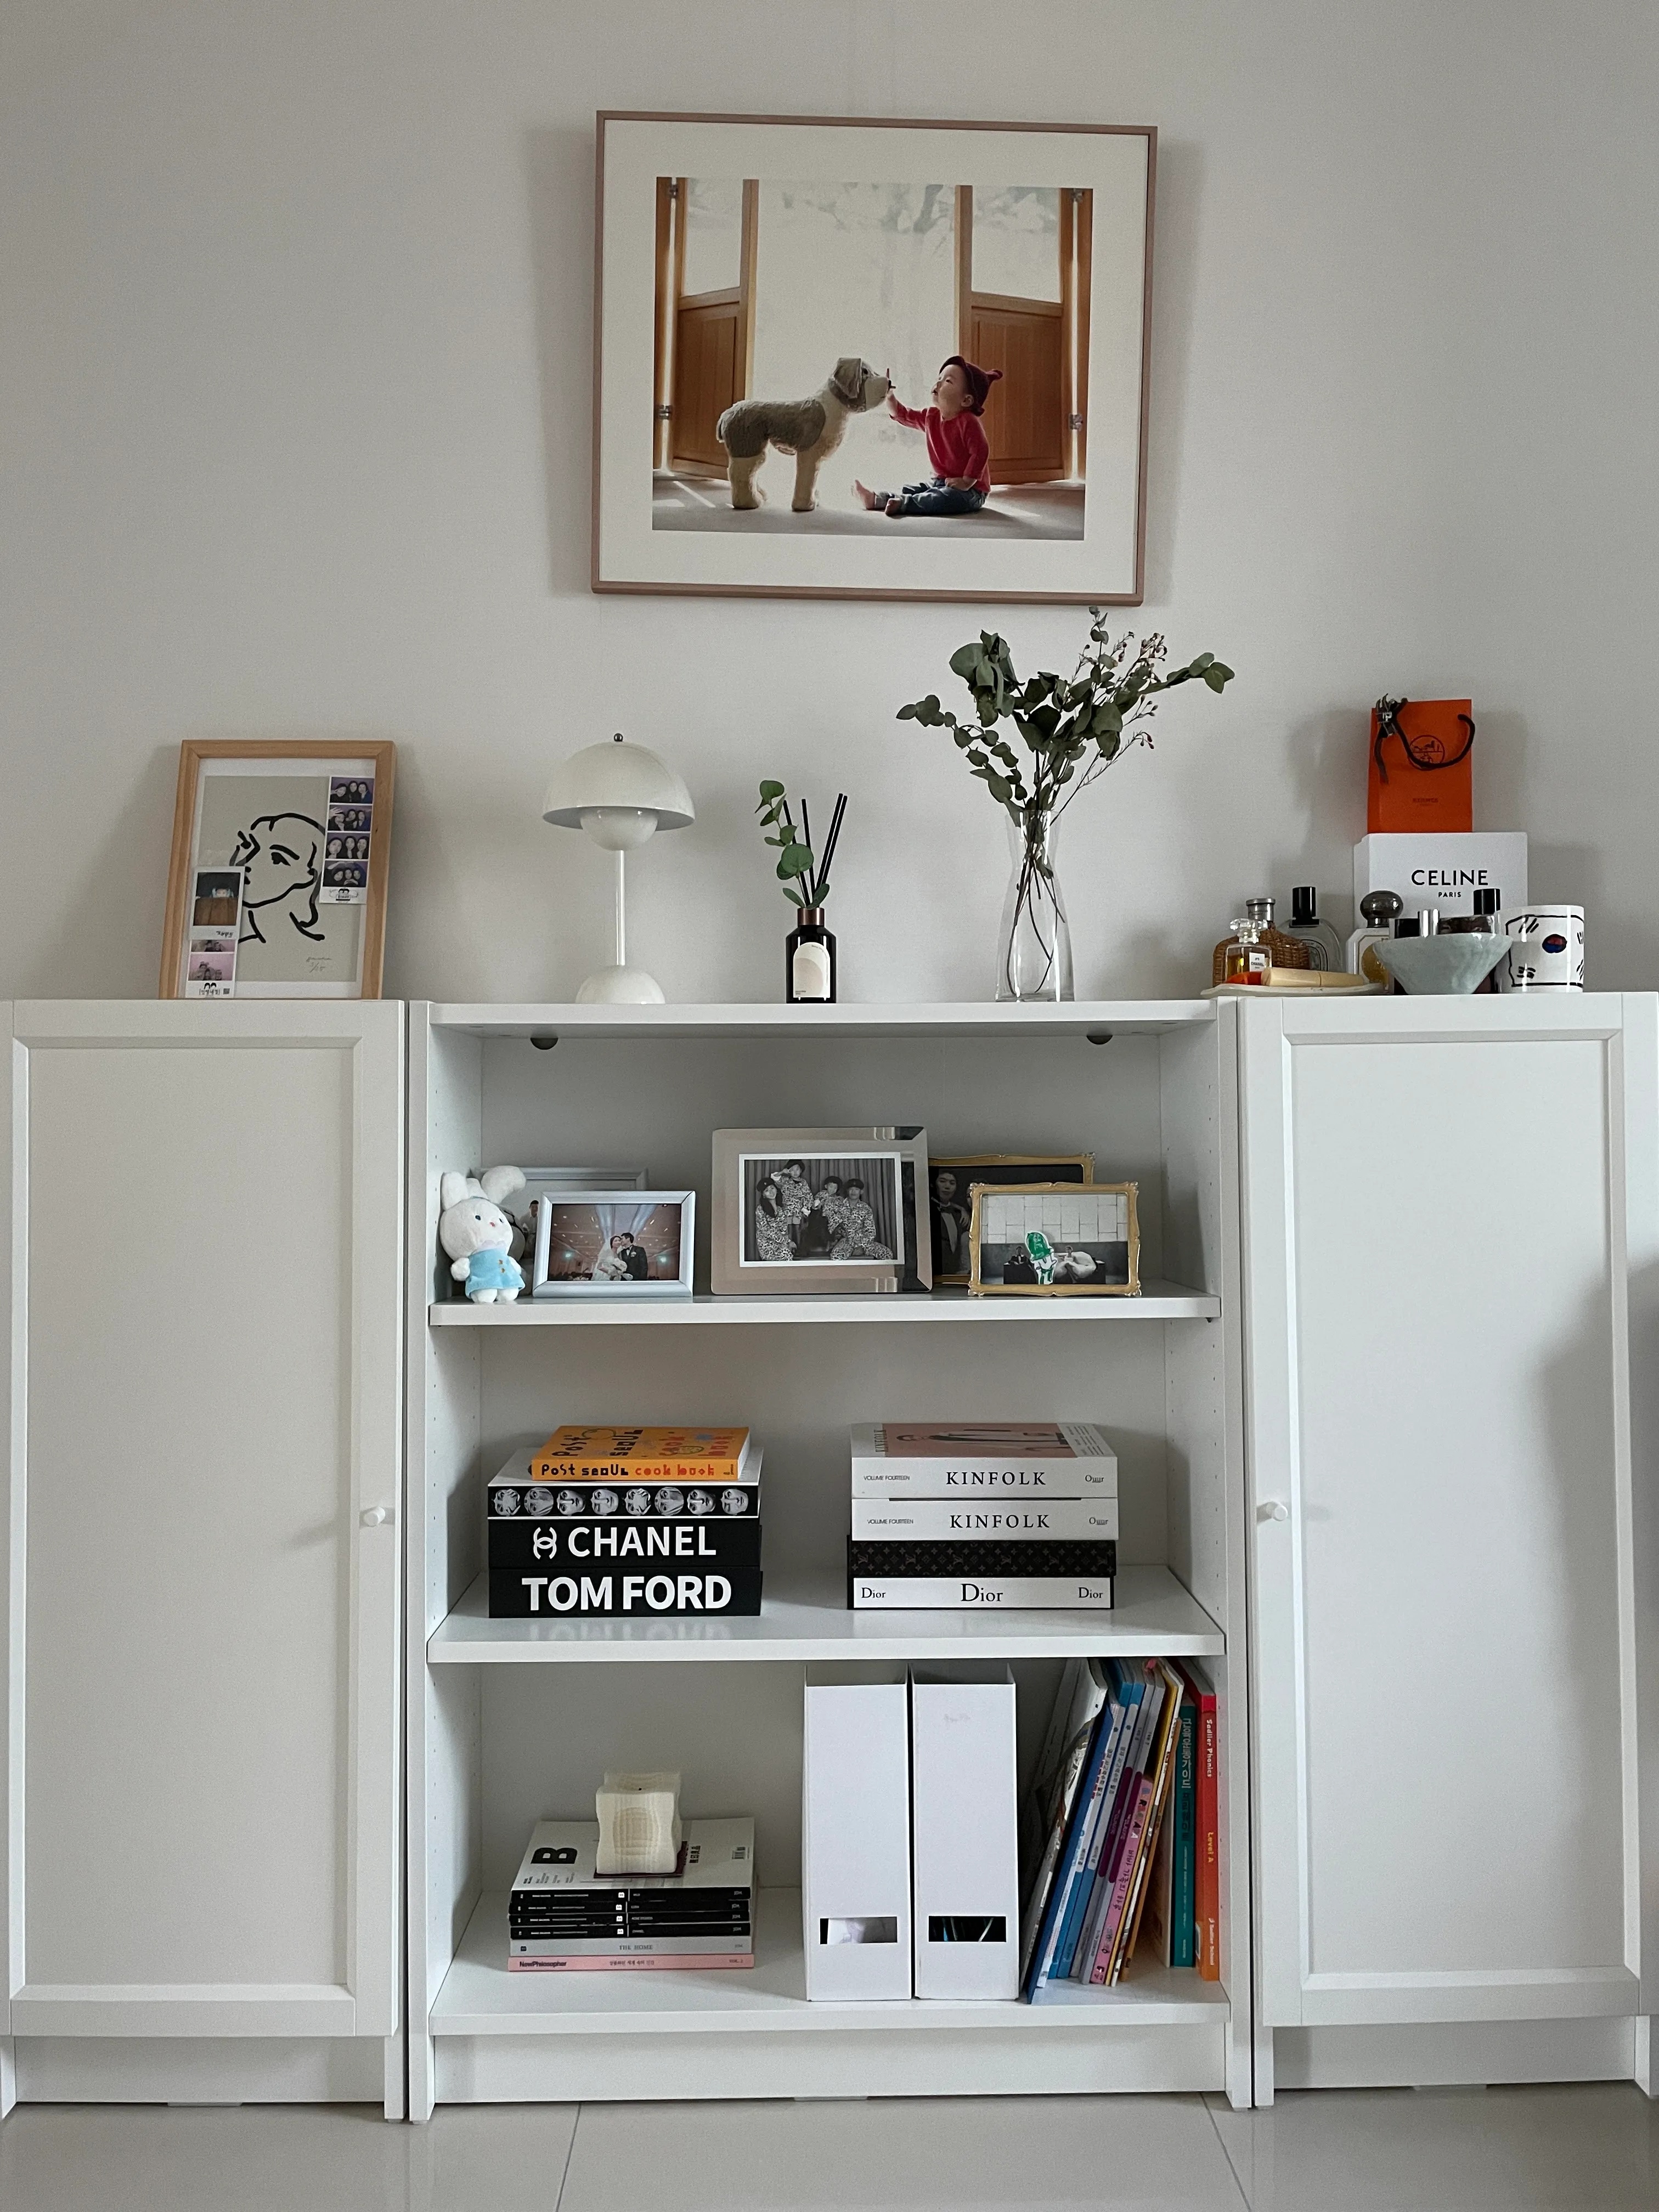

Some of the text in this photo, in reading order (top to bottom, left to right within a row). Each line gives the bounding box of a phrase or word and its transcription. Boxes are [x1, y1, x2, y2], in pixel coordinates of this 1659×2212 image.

[1411, 870, 1489, 886] CELINE
[946, 1472, 1046, 1485] KINFOLK
[950, 1515, 1050, 1528] KINFOLK
[568, 1526, 716, 1557] CHANEL
[521, 1575, 732, 1611] TOM FORD
[861, 1587, 886, 1599] Dior
[961, 1583, 1003, 1602] Dior
[1078, 1587, 1103, 1599] Dior
[531, 1847, 578, 1864] B
[1125, 1849, 1135, 1867] 바바
[1118, 1869, 1130, 1892] 가족의
